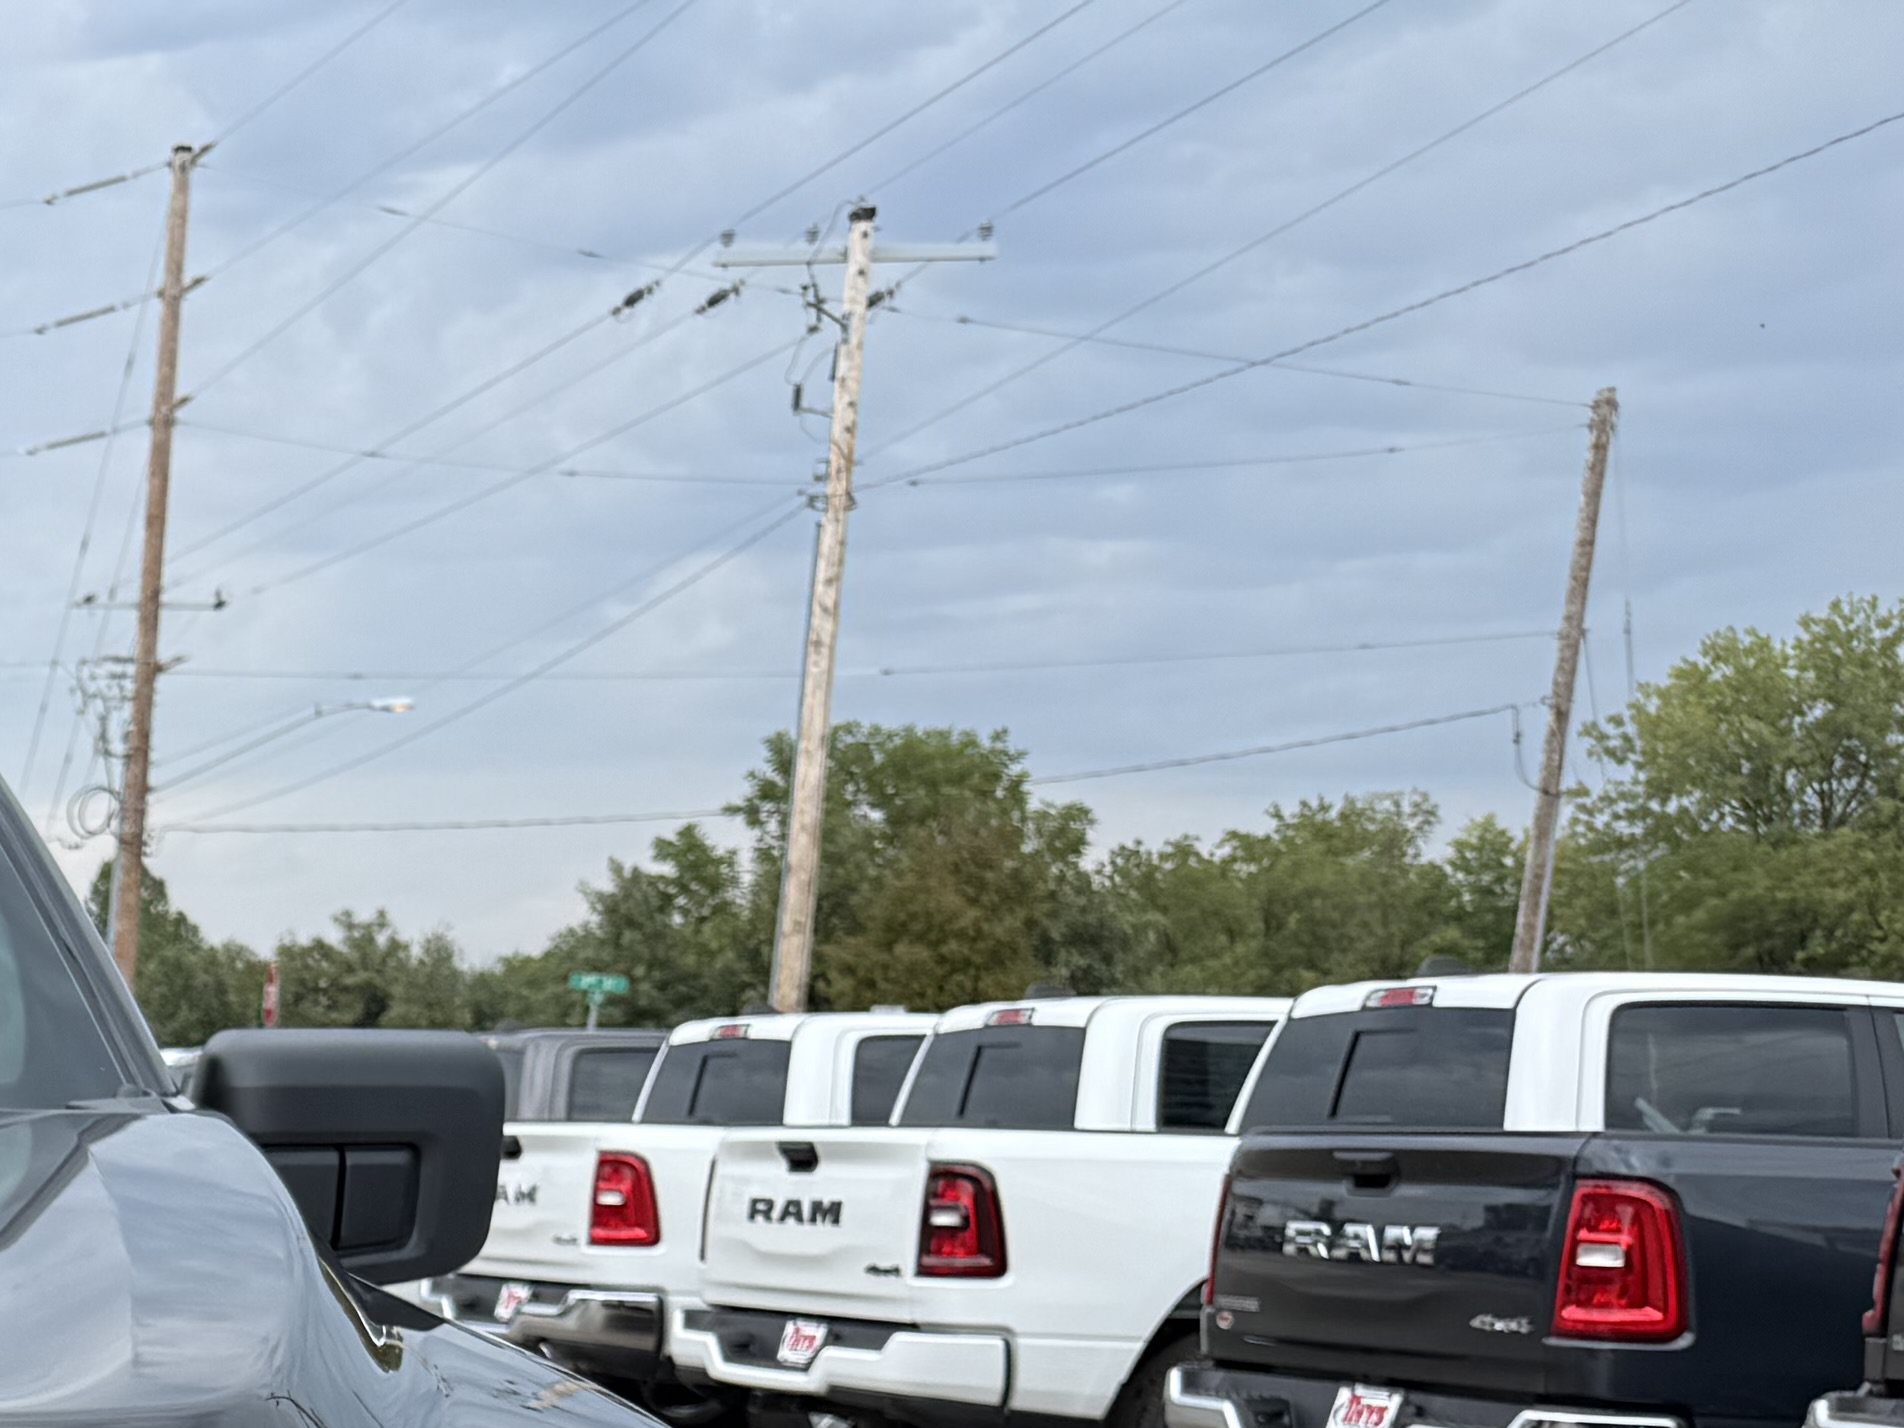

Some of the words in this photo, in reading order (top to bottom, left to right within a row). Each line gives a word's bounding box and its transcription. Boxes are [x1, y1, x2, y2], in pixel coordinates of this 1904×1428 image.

[495, 1184, 537, 1206] AM
[747, 1198, 843, 1226] RAM
[1282, 1220, 1442, 1267] RAM
